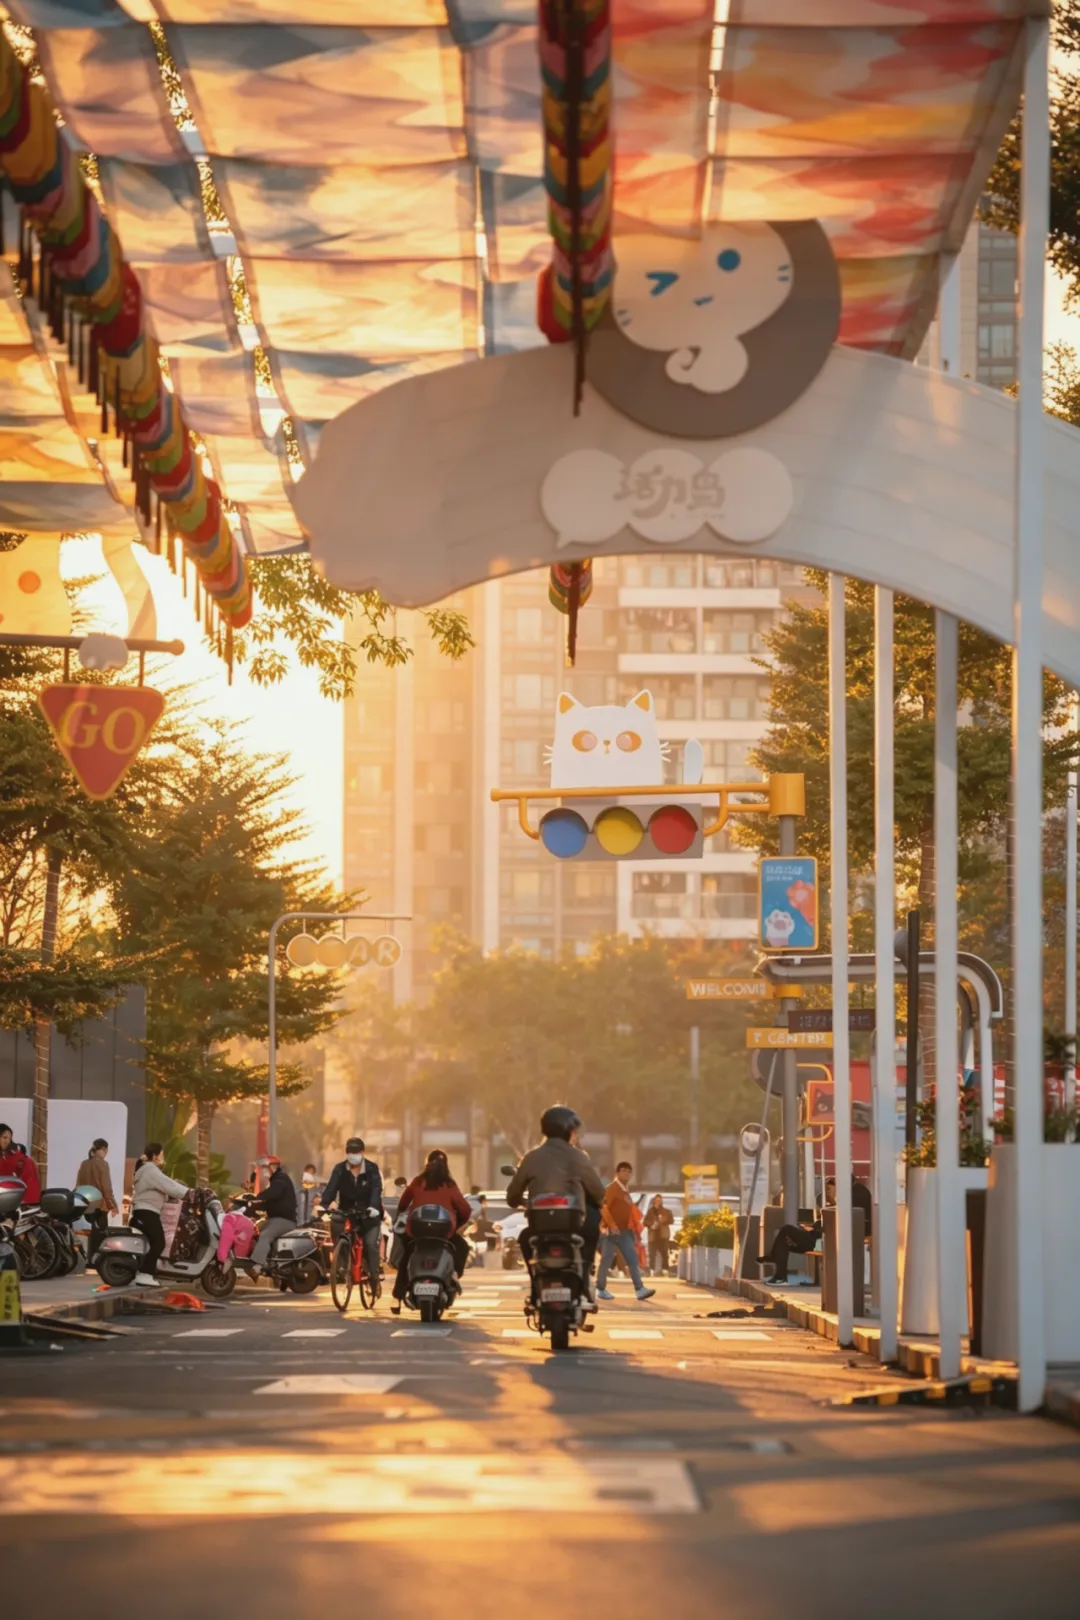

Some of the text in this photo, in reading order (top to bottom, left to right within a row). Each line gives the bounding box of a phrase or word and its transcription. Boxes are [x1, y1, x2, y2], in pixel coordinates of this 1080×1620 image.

[58, 700, 146, 756] GO
[690, 981, 767, 997] WELCOME
[767, 1031, 828, 1045] CENTER
